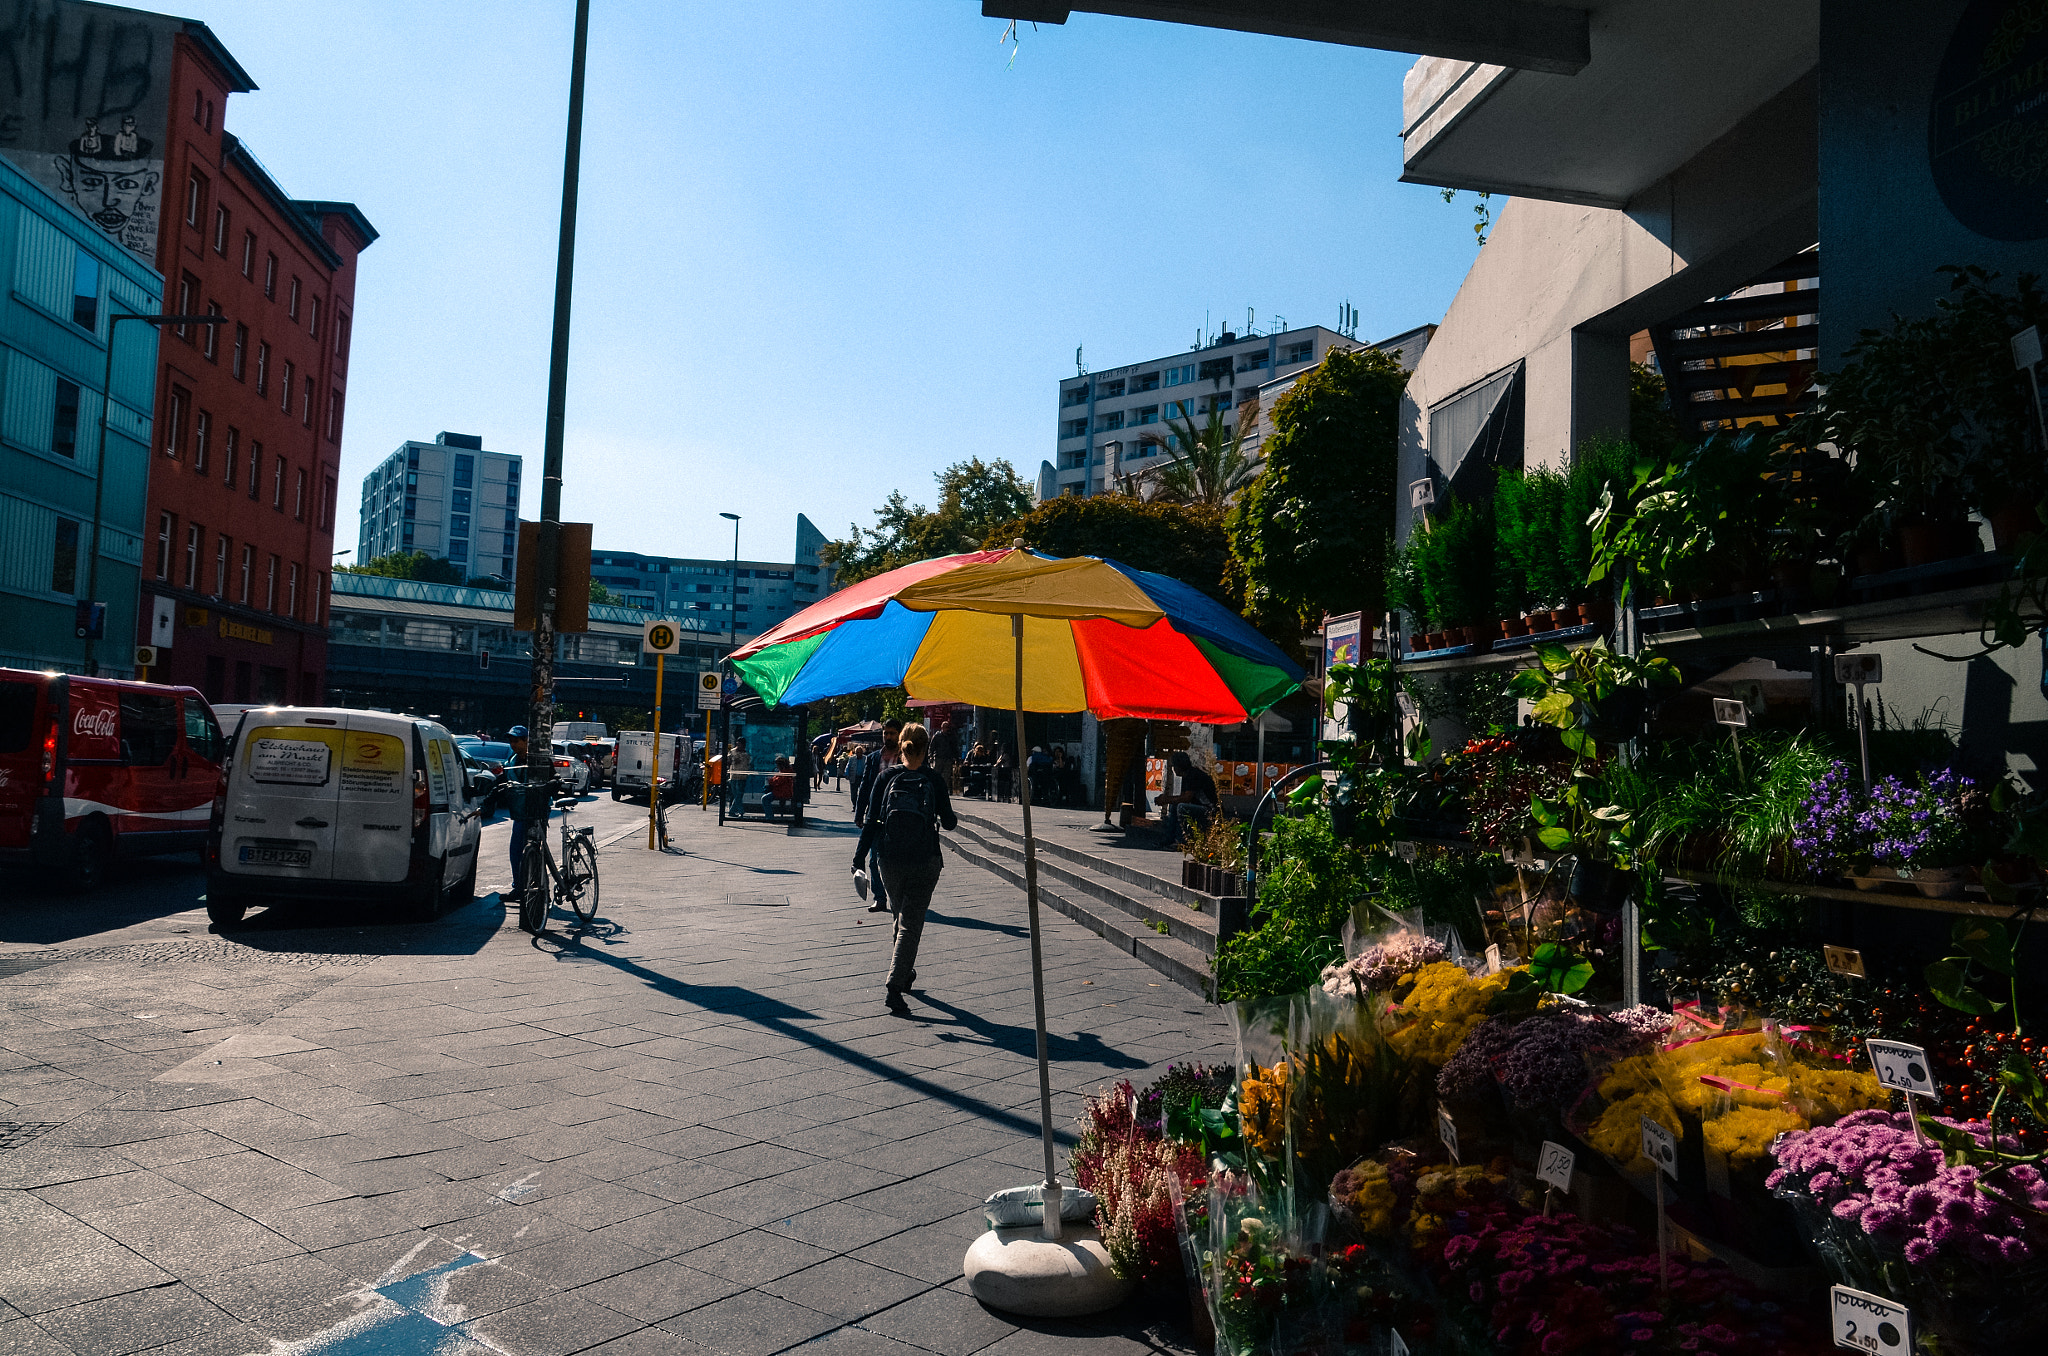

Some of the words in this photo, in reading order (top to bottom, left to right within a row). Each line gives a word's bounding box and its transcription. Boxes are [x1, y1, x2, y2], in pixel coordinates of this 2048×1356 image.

[258, 740, 325, 753] Elektrohaus
[279, 751, 323, 762] Markt
[1884, 1065, 1912, 1088] 2.50
[1845, 1320, 1878, 1351] 2.50
